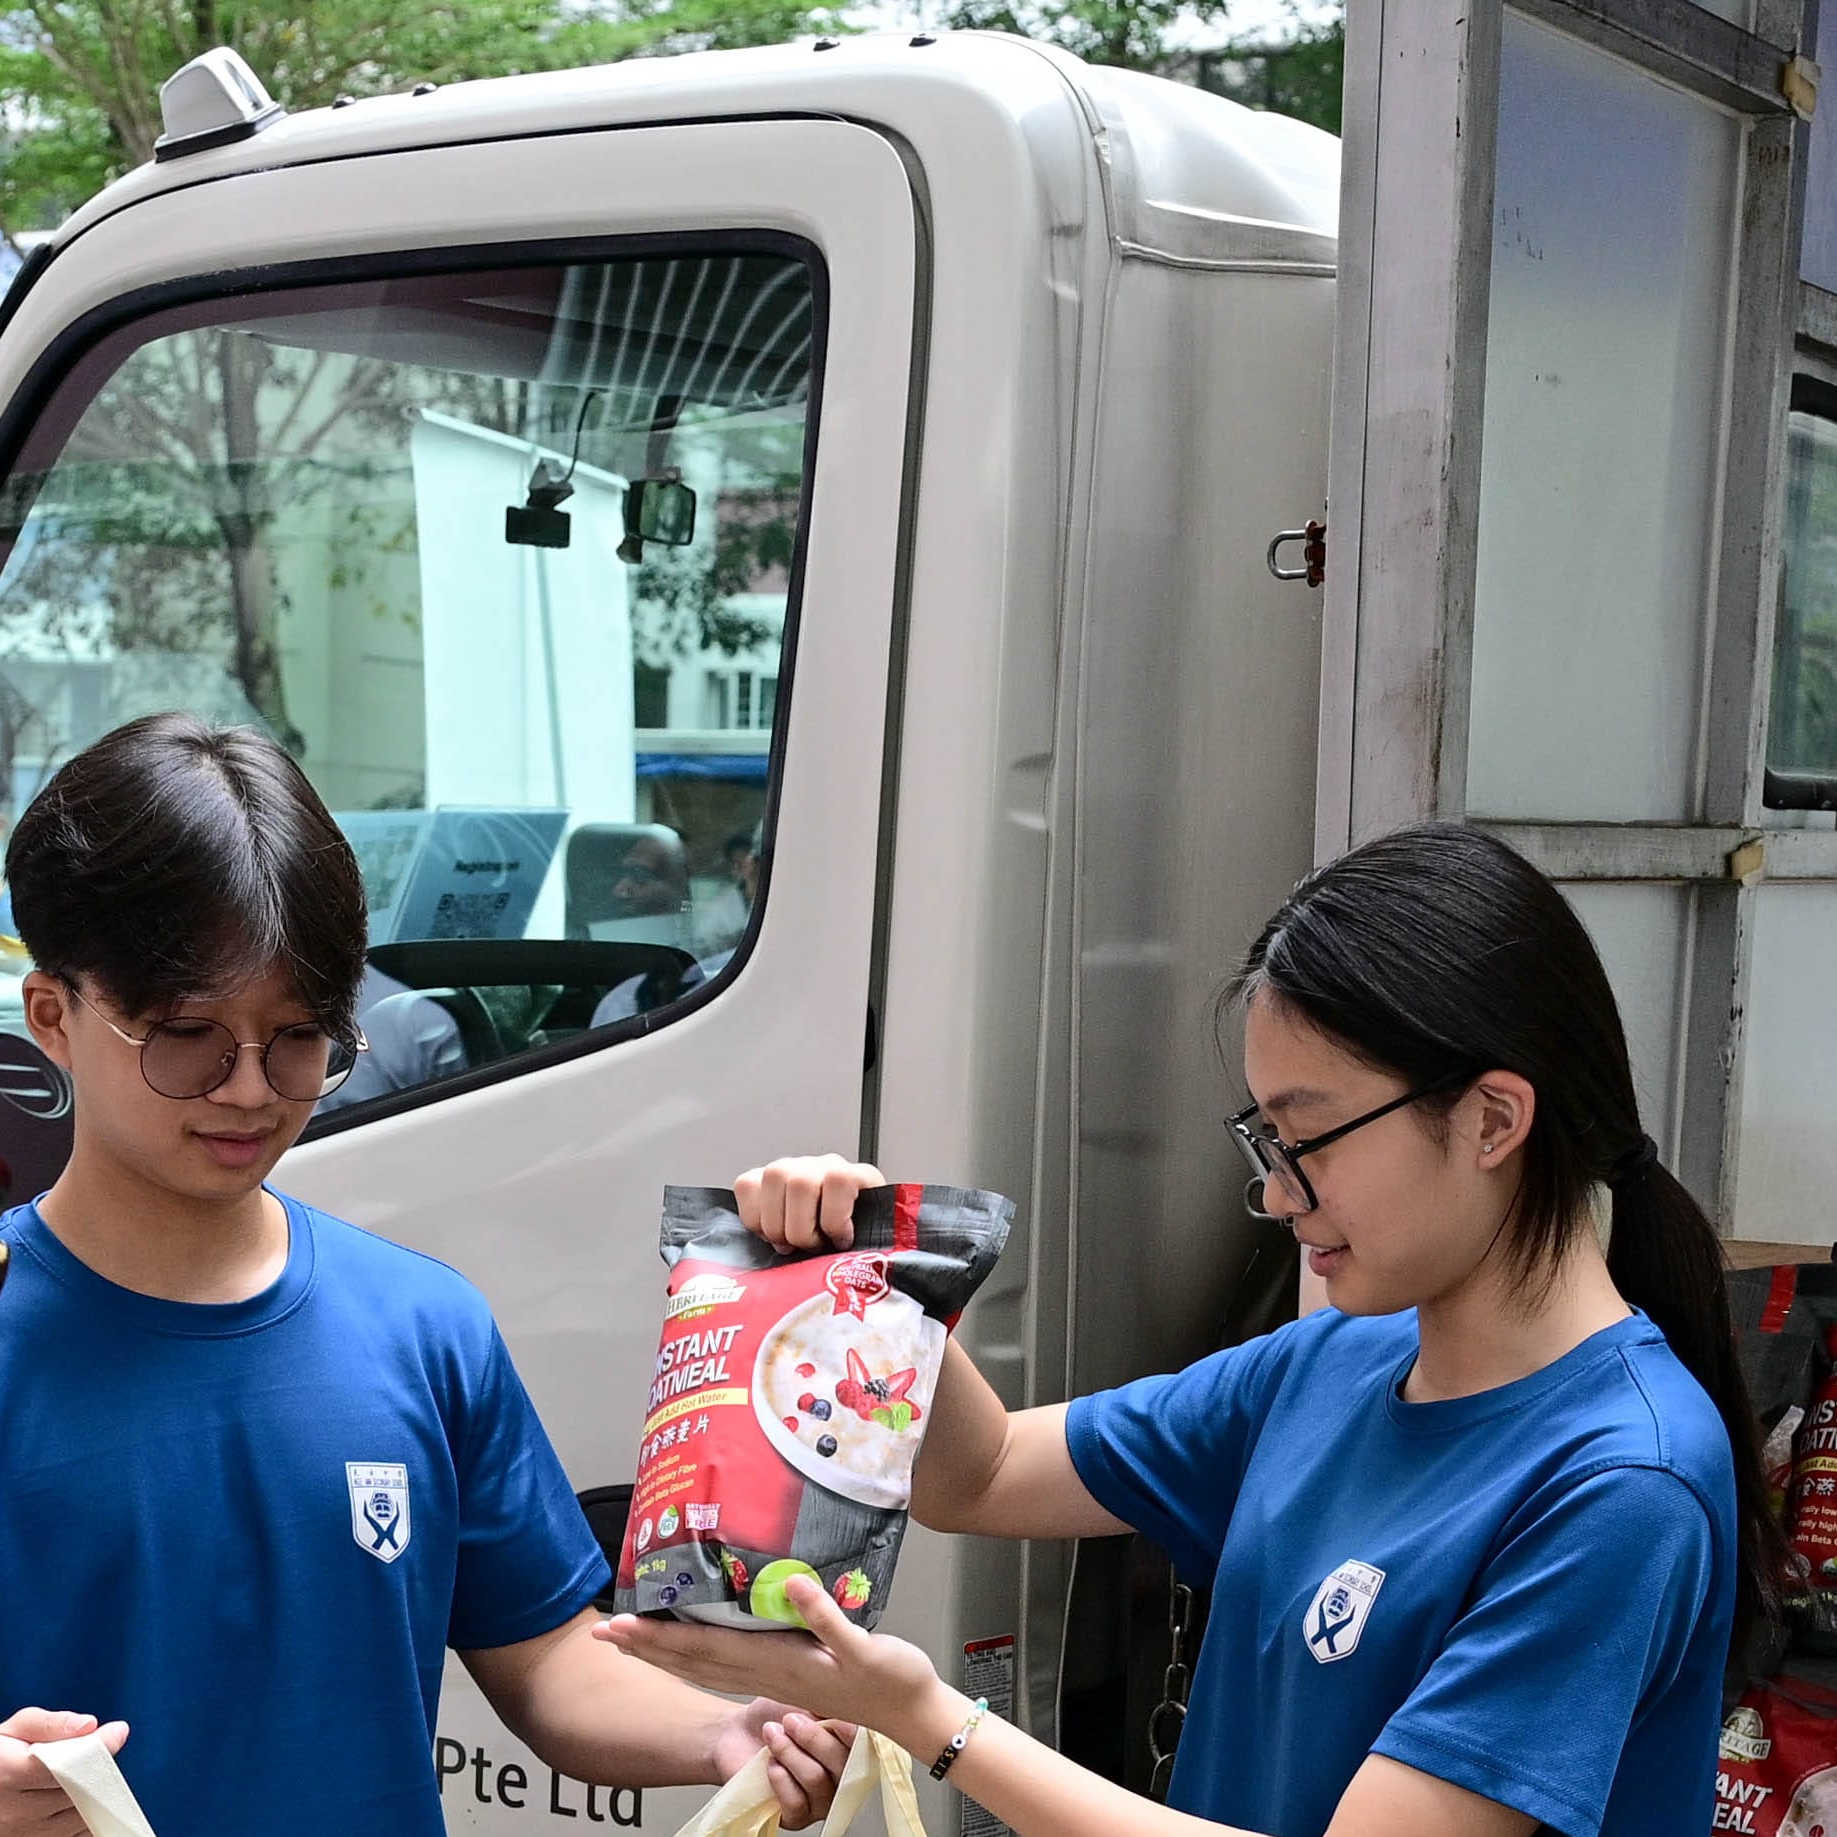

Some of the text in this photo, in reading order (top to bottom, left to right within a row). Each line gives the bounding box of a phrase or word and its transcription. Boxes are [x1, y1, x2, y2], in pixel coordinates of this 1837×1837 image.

[1821, 1506, 1837, 1517] low
[1811, 1535, 1832, 1546] Beta
[435, 1736, 528, 1808] Pte
